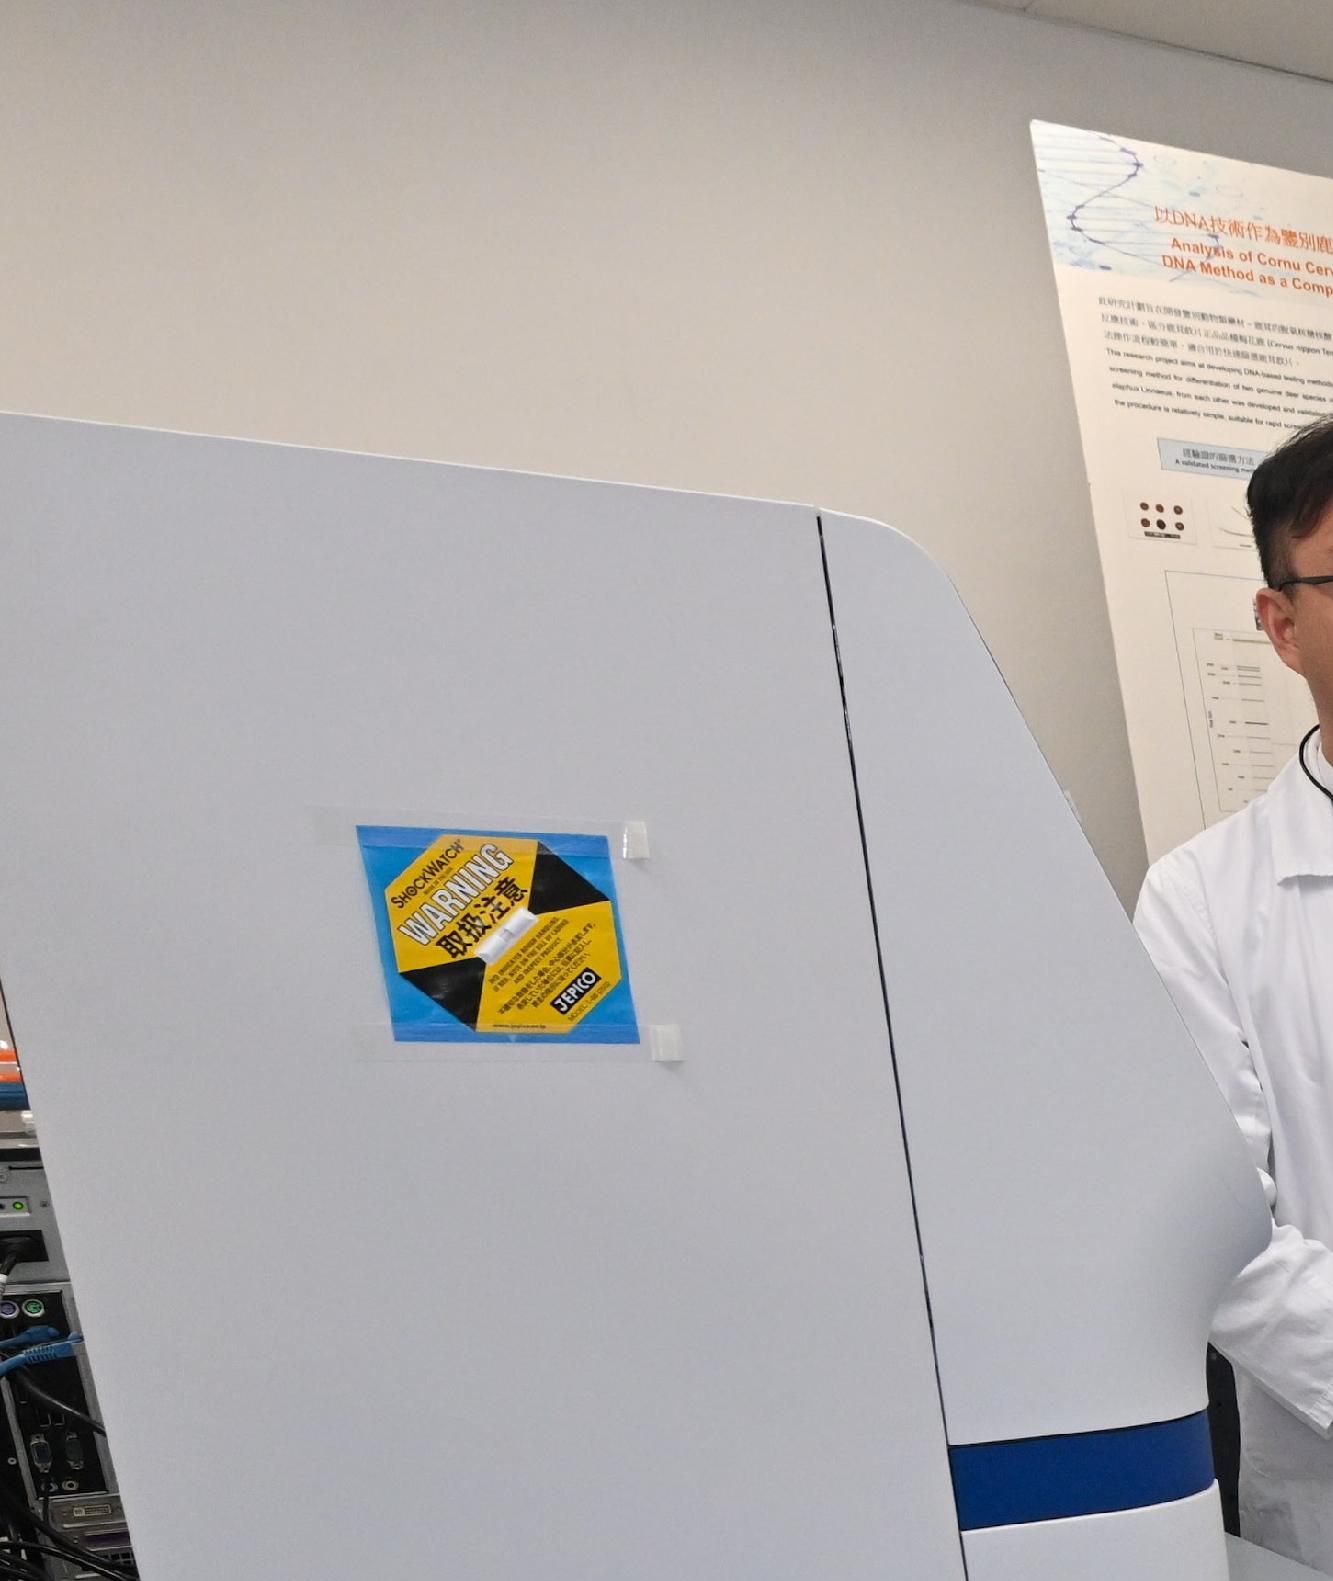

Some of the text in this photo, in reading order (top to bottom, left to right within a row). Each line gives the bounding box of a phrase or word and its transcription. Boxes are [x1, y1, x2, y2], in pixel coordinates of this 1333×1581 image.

[1161, 255, 1196, 271] DNA
[1200, 261, 1254, 281] Method
[1259, 274, 1276, 285] as
[1279, 278, 1288, 287] a
[1171, 237, 1234, 261] Analysis
[1239, 250, 1253, 262] of
[1257, 254, 1301, 272] Cornu
[397, 843, 514, 946] WARNING
[436, 876, 527, 958] 取扱注意
[554, 971, 596, 1012] JEPICO
